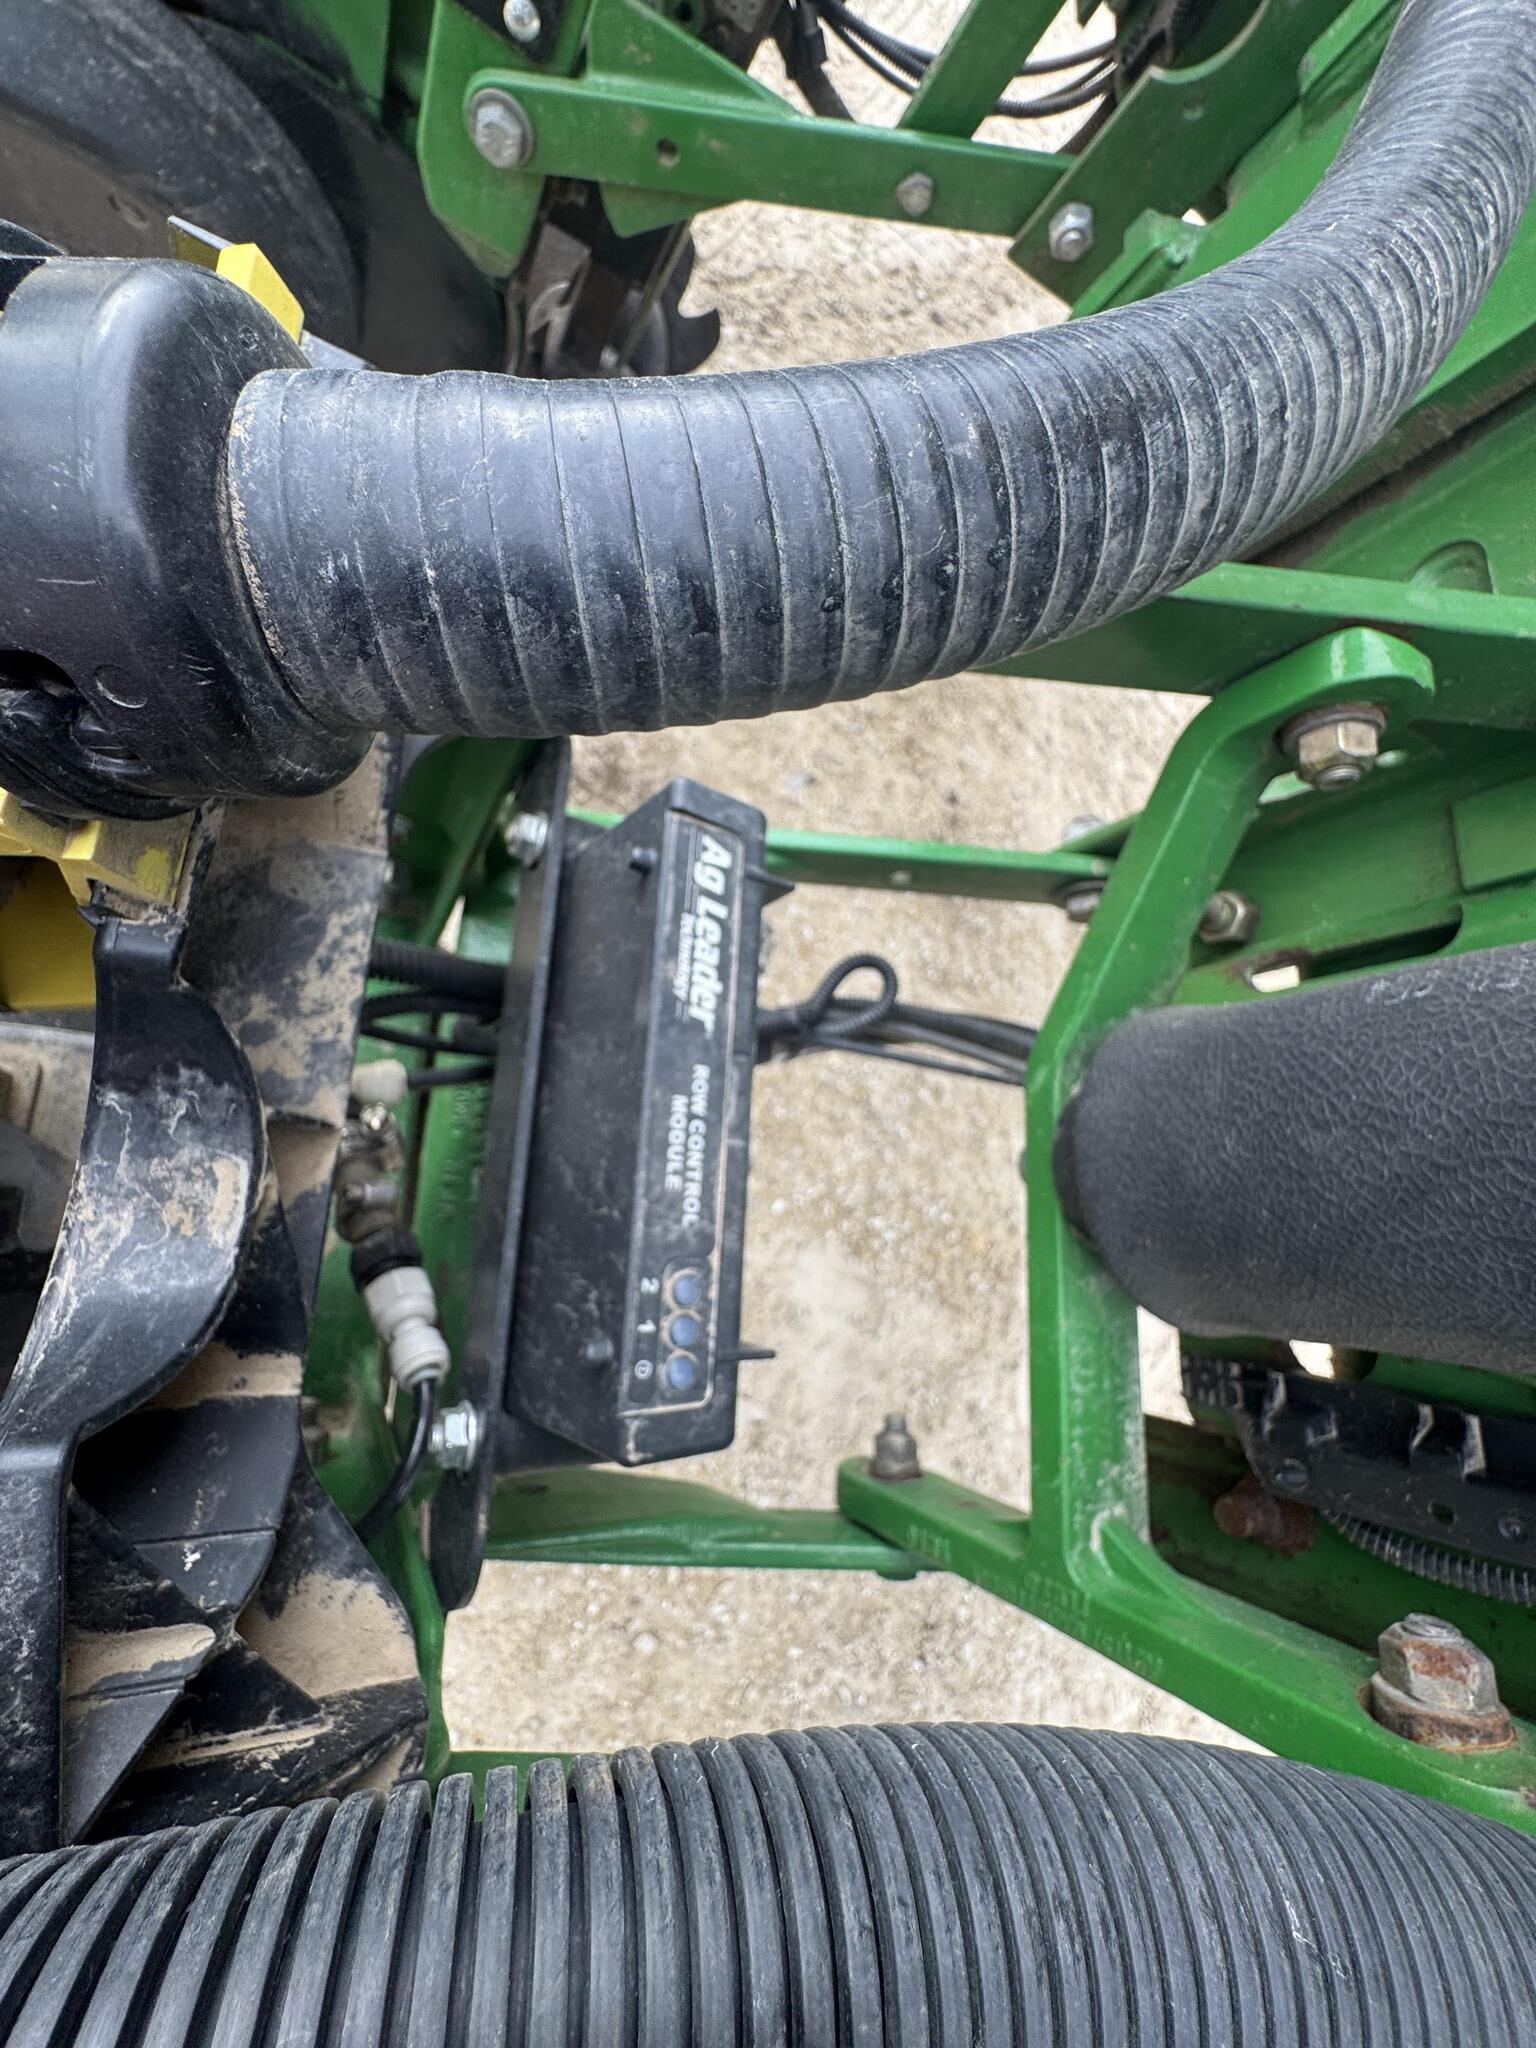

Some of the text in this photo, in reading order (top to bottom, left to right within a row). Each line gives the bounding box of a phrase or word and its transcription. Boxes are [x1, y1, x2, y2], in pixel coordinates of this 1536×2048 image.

[687, 833, 734, 1040] Ag Leader
[663, 1093, 690, 1193] MODULE
[681, 1063, 711, 1228] ROW CONTROL
[636, 1318, 657, 1335] 1
[639, 1276, 661, 1295] 2
